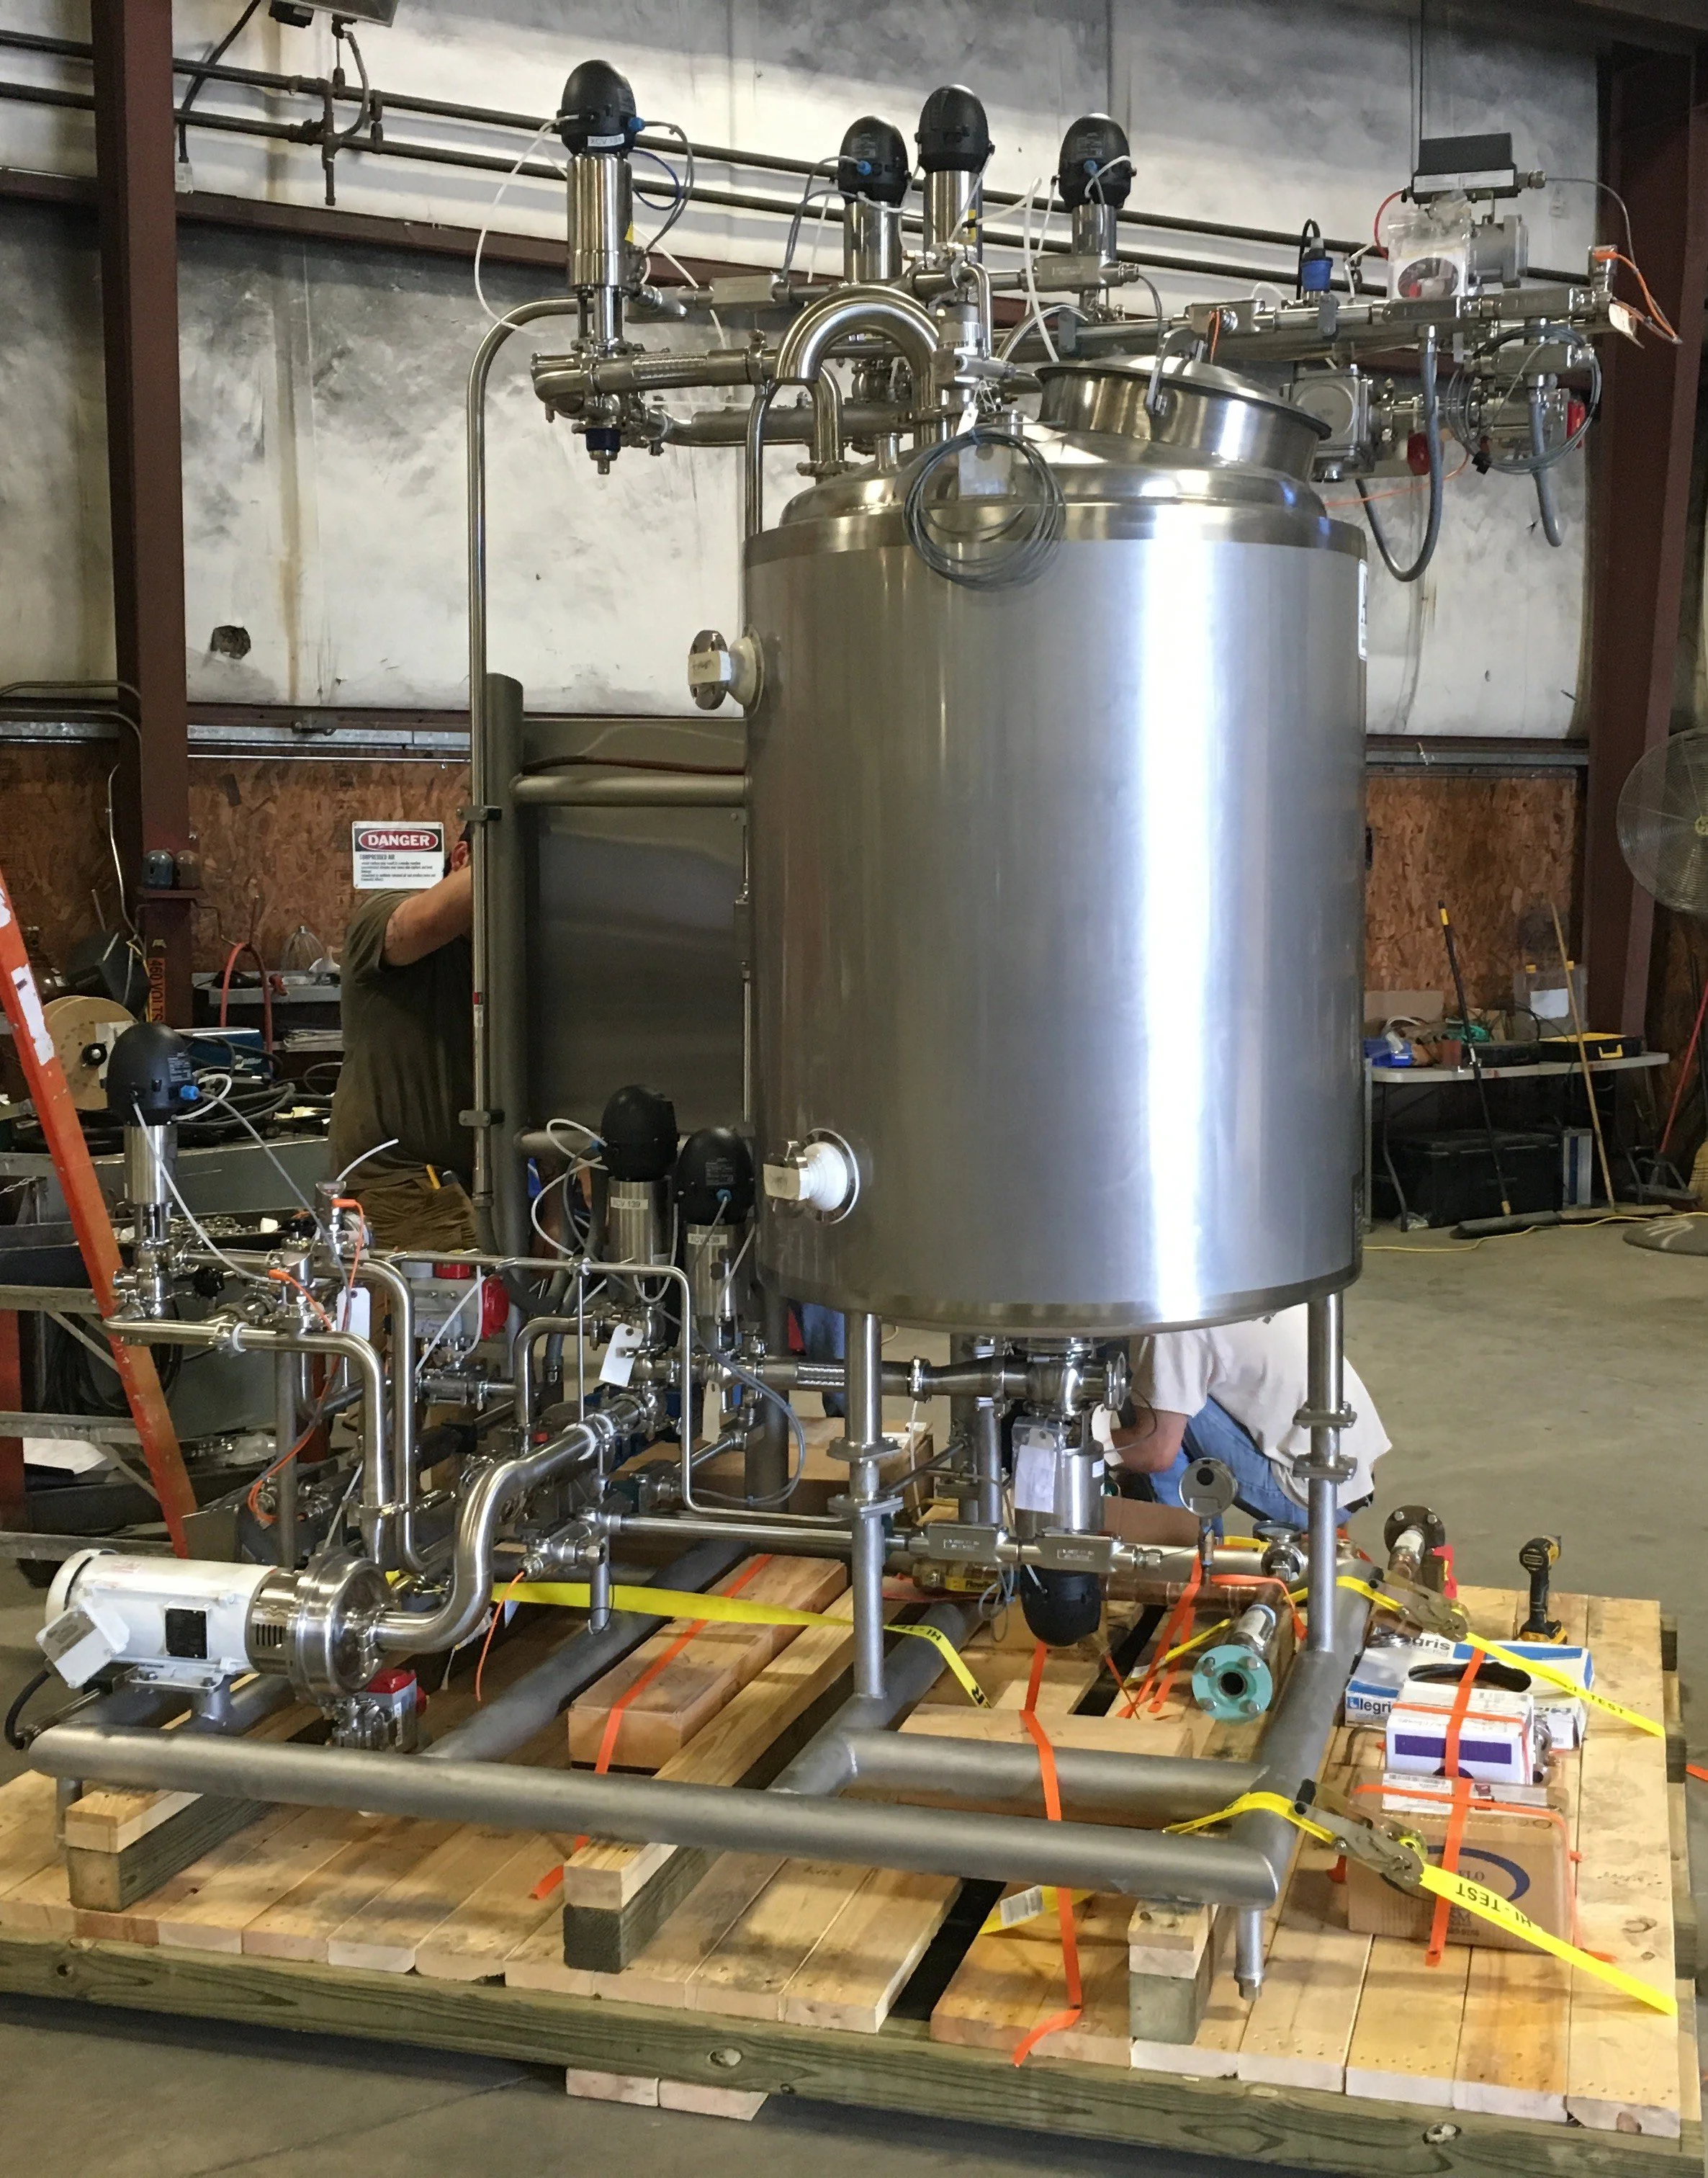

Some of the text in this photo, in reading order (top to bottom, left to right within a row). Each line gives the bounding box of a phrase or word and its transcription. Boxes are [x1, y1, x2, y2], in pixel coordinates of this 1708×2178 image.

[368, 834, 431, 847] DANGER
[150, 960, 163, 1021] 460 VOLTS
[1359, 1697, 1393, 1715] legri
[1455, 1883, 1501, 1913] TEST
